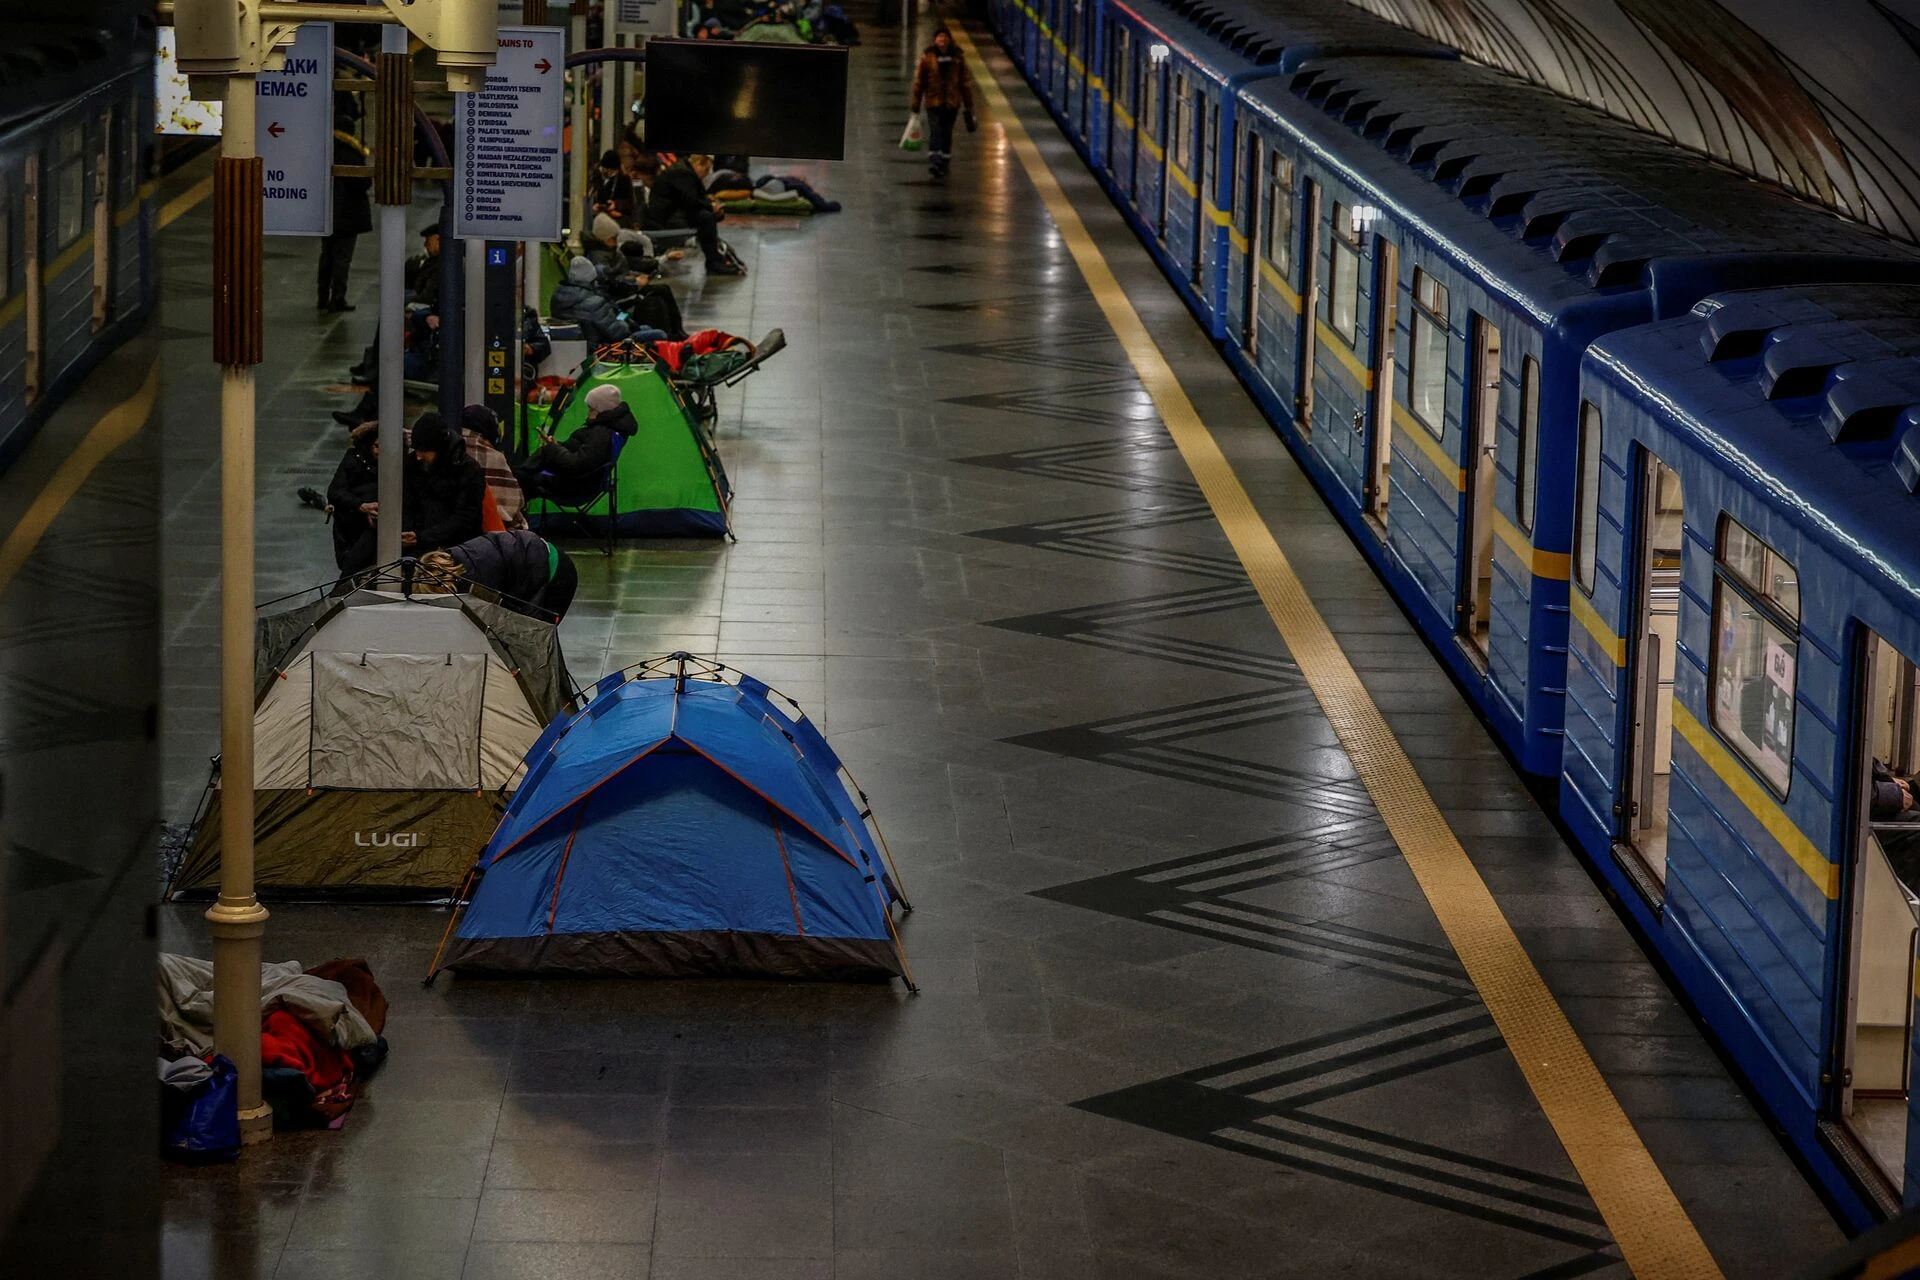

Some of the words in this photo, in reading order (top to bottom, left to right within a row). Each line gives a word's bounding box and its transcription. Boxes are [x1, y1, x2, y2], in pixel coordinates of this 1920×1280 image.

[497, 39, 521, 48] RAINS
[523, 39, 533, 48] TO
[478, 93, 519, 101] VASYLKIVSKA
[478, 110, 512, 118] DEMIIVSKA
[502, 154, 551, 162] NEZALEZHNOSTI
[267, 170, 284, 182] NO
[521, 172, 553, 180] PLOSHCHA
[262, 187, 308, 200] ARDING
[355, 832, 417, 847] LUGI
